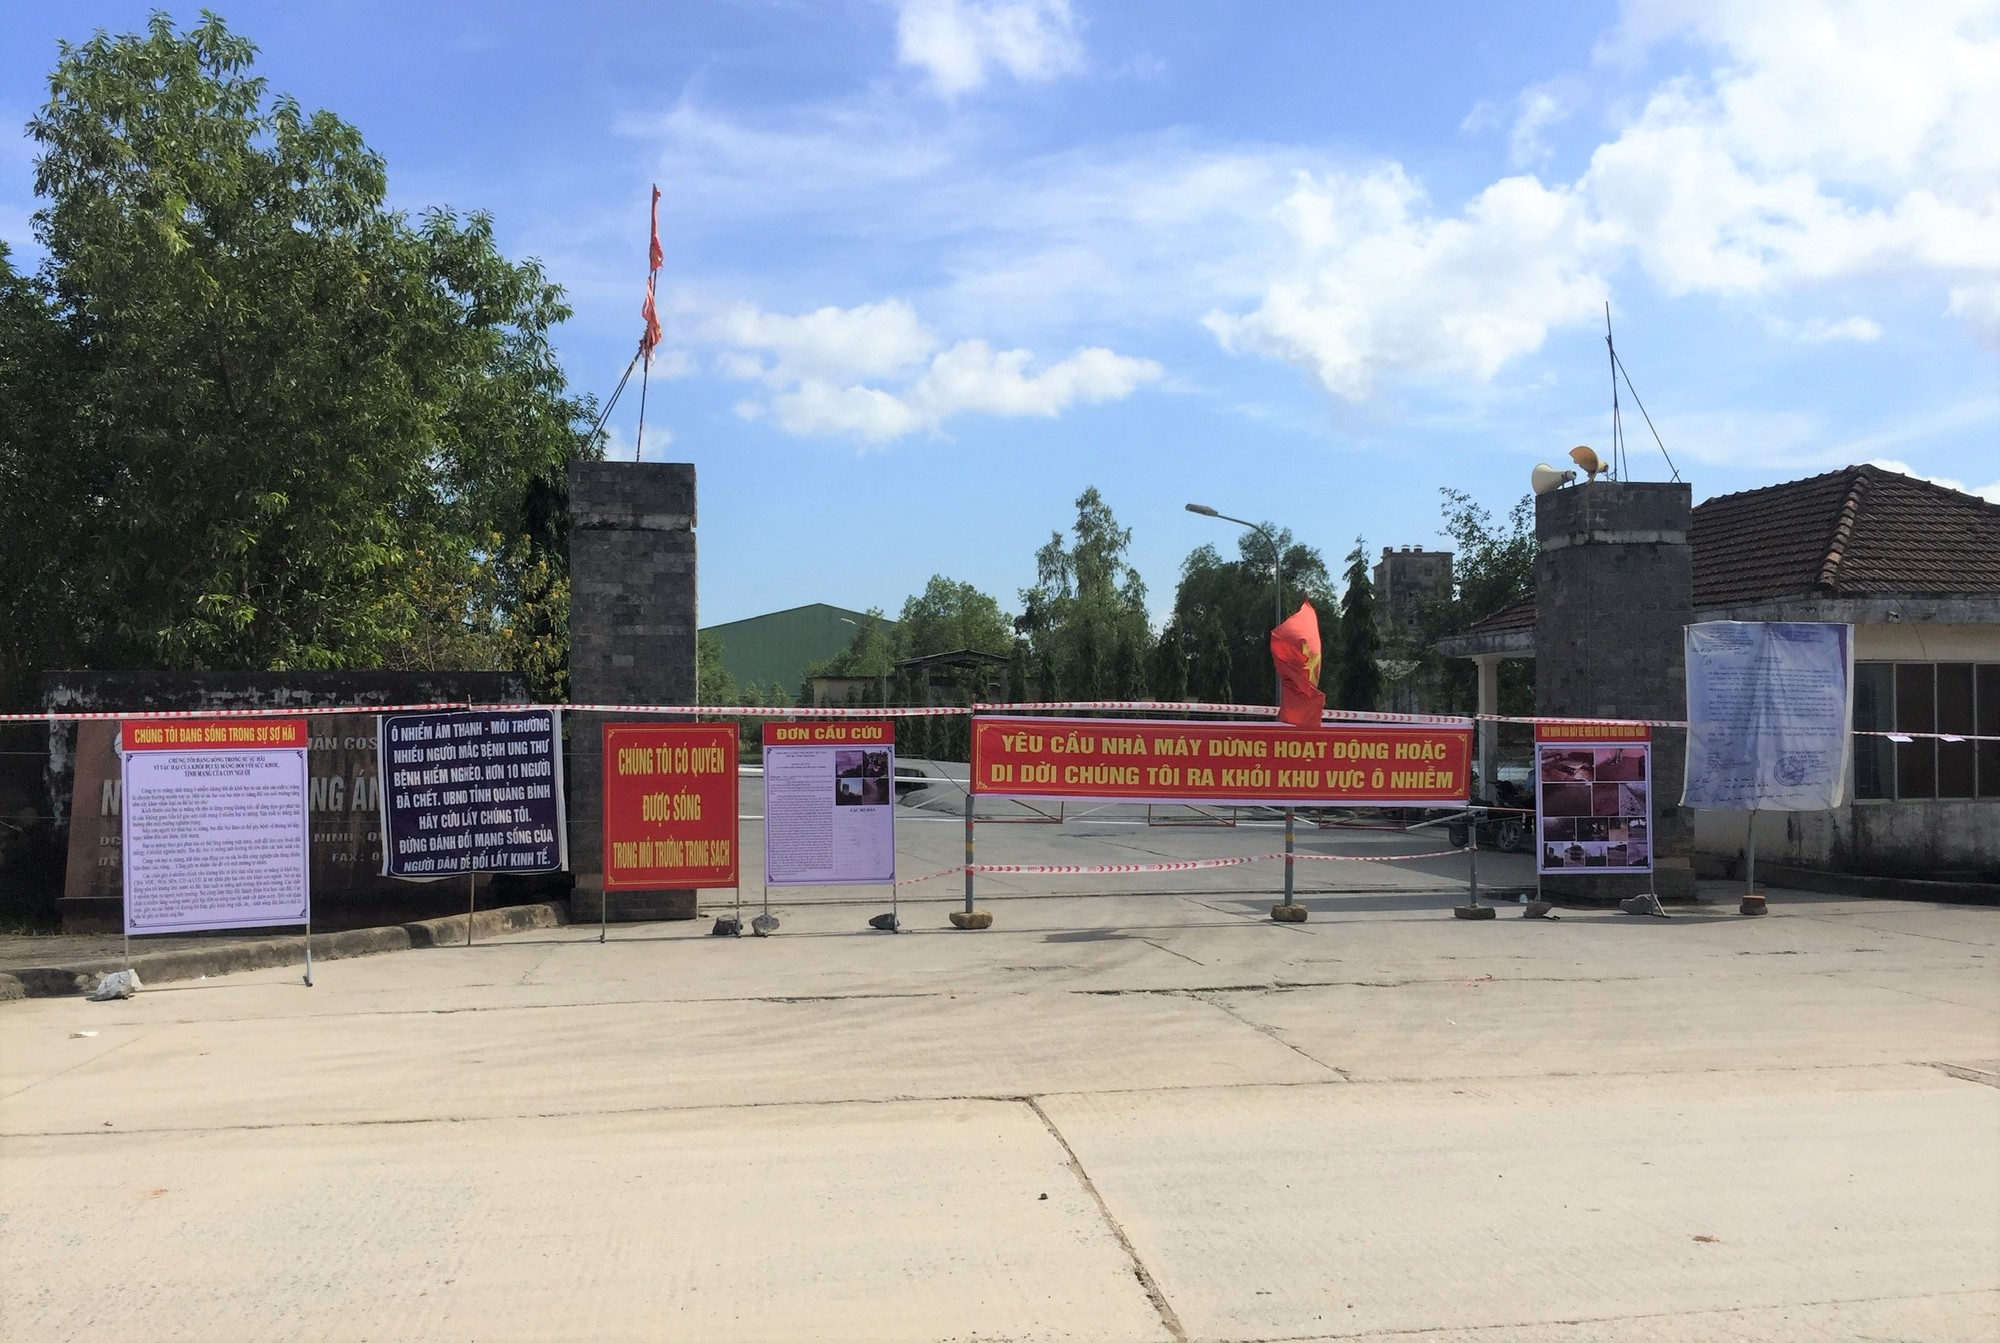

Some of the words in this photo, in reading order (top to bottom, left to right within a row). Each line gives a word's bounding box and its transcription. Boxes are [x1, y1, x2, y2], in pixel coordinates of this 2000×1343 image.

[134, 726, 163, 743] CHÚNG
[165, 726, 177, 742] TÔI
[180, 728, 202, 742] ĐANG
[205, 725, 226, 742] SỐNG
[229, 727, 254, 741] TRONG
[257, 726, 268, 744] SỰ
[270, 726, 280, 743] SỢ
[282, 725, 295, 740] HÃI
[392, 726, 398, 741] Ô
[435, 723, 450, 739] ÂM
[453, 722, 482, 737] THANH
[491, 719, 509, 734] MÔI
[512, 716, 549, 733] TRƯỜNG
[776, 728, 809, 740] ĐƠN
[815, 724, 846, 739] CẦU
[851, 726, 882, 739] CỨU
[344, 737, 377, 750] COS
[427, 746, 456, 761] NGƯỜI
[459, 740, 478, 758] MẮC
[481, 741, 505, 759] BỆNH
[508, 741, 527, 755] UNG
[530, 739, 549, 754] THƯ
[1002, 732, 1043, 752] YÊU
[1051, 731, 1094, 753] CẦU
[1102, 735, 1147, 755] NHÀ
[1155, 736, 1201, 755] MÁY
[1209, 737, 1266, 757] DỪNG
[1275, 741, 1327, 761] HOẠT
[1333, 739, 1388, 762] ĐỘNG
[1395, 740, 1446, 763] HOẶC
[619, 743, 653, 775] CHÚNG
[656, 743, 671, 775] TÔI
[675, 742, 688, 773] CÓ
[692, 739, 724, 777] QUYỀN
[394, 769, 421, 789] BỆNH
[423, 764, 448, 784] HIỂM
[451, 766, 483, 782] NGHÈO.
[486, 764, 504, 780] HƠN
[507, 764, 518, 778] 10
[521, 761, 550, 777] NGƯỜI
[992, 764, 1012, 782] DI
[1021, 761, 1056, 783] DỜI
[1065, 763, 1139, 784] CHÚNG
[1147, 764, 1179, 785] TÔI
[1188, 768, 1214, 786] RA
[1222, 764, 1270, 787] KHỎI
[1278, 770, 1319, 788] KHU
[1326, 770, 1364, 791] VỰC
[1372, 768, 1384, 788] Ô
[1391, 766, 1453, 788] NHIỄM
[310, 775, 344, 811] NG
[397, 795, 410, 808] ĐÃ
[413, 788, 440, 807] CHẾT.
[443, 790, 467, 805] UBND
[469, 784, 491, 802] TỈNH
[493, 782, 524, 803] QUẢNG
[527, 783, 550, 799] BÌNH
[643, 792, 670, 827] ĐƯỢC
[673, 785, 700, 821] SỐNG
[419, 813, 438, 829] HÃY
[441, 810, 460, 828] CỨU
[462, 807, 477, 826] LẤY
[481, 807, 512, 824] CHÚNG
[514, 806, 531, 822] TÔI.
[400, 836, 427, 854] ĐỪNG
[430, 834, 456, 851] ĐÁNH
[475, 832, 503, 849] MẠNG
[507, 827, 532, 844] SỐNG
[534, 824, 553, 843] CỦA
[404, 857, 434, 871] NGƯỜI
[438, 856, 457, 869] DÂN
[491, 851, 508, 867] LẤY
[511, 853, 533, 866] KINH
[537, 846, 550, 864] TẾ.
[613, 842, 637, 868] TRONG
[639, 836, 653, 868] MÔI
[655, 835, 683, 867] TRƯỜNG
[685, 840, 708, 867] TRONG
[711, 840, 729, 871] SẠCH
